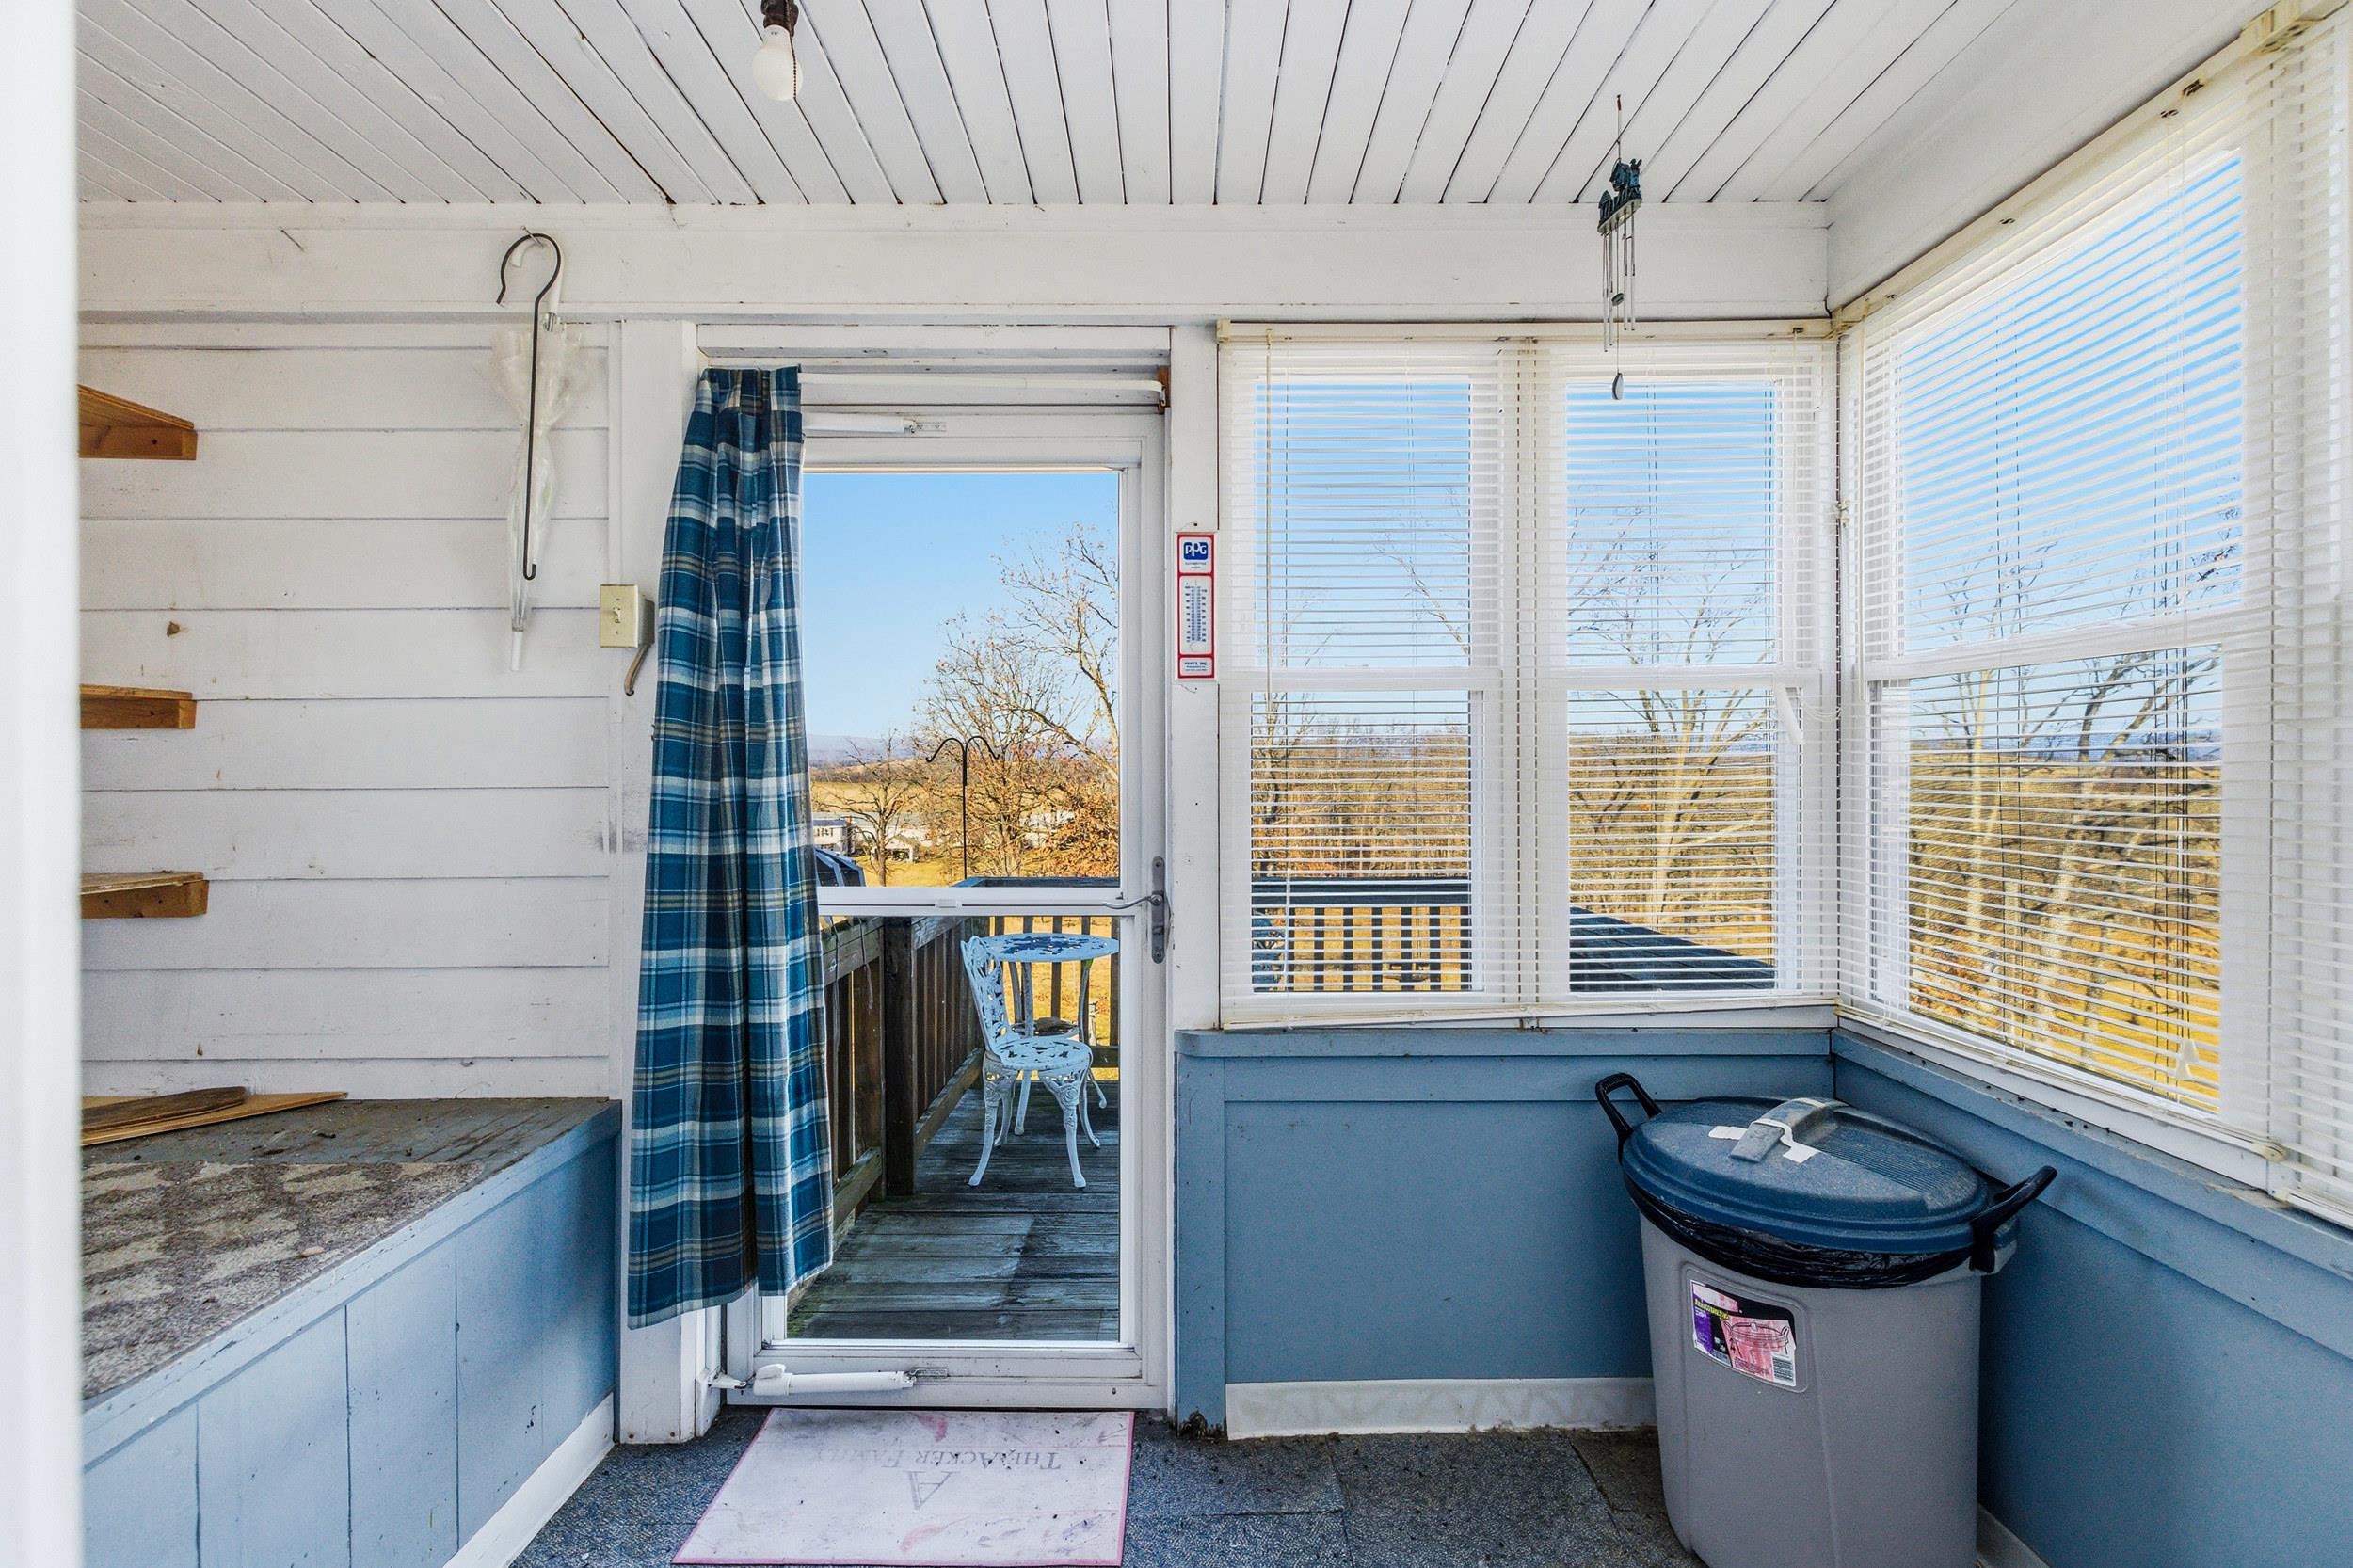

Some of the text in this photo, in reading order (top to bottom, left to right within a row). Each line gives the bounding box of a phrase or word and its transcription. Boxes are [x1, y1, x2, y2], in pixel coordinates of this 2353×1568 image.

[1185, 541, 1207, 557] PPG
[916, 1450, 1001, 1469] ACKER
[1006, 1450, 1062, 1470] THE
[904, 1470, 960, 1510] A
